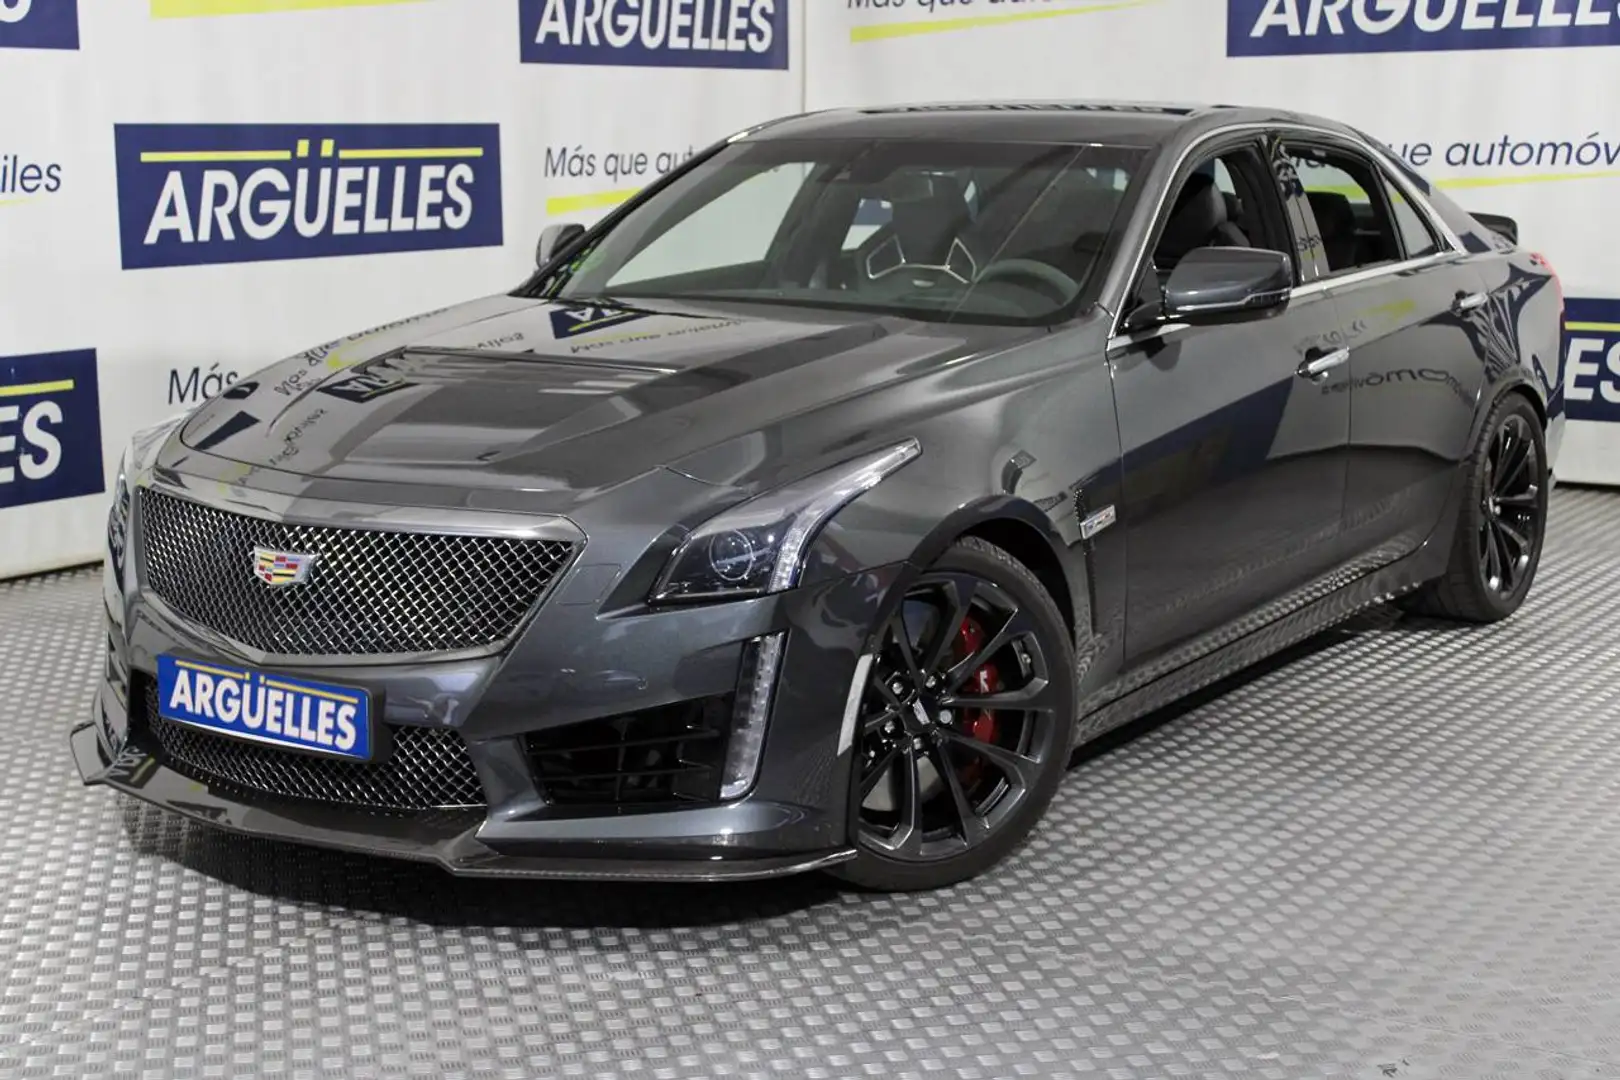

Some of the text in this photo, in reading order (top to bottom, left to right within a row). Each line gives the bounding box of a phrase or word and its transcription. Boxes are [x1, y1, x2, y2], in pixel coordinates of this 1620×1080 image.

[143, 139, 475, 245] ARGÜELLES
[544, 145, 597, 178] Más
[603, 151, 648, 182] que
[169, 669, 357, 750] ARGÜELLES
